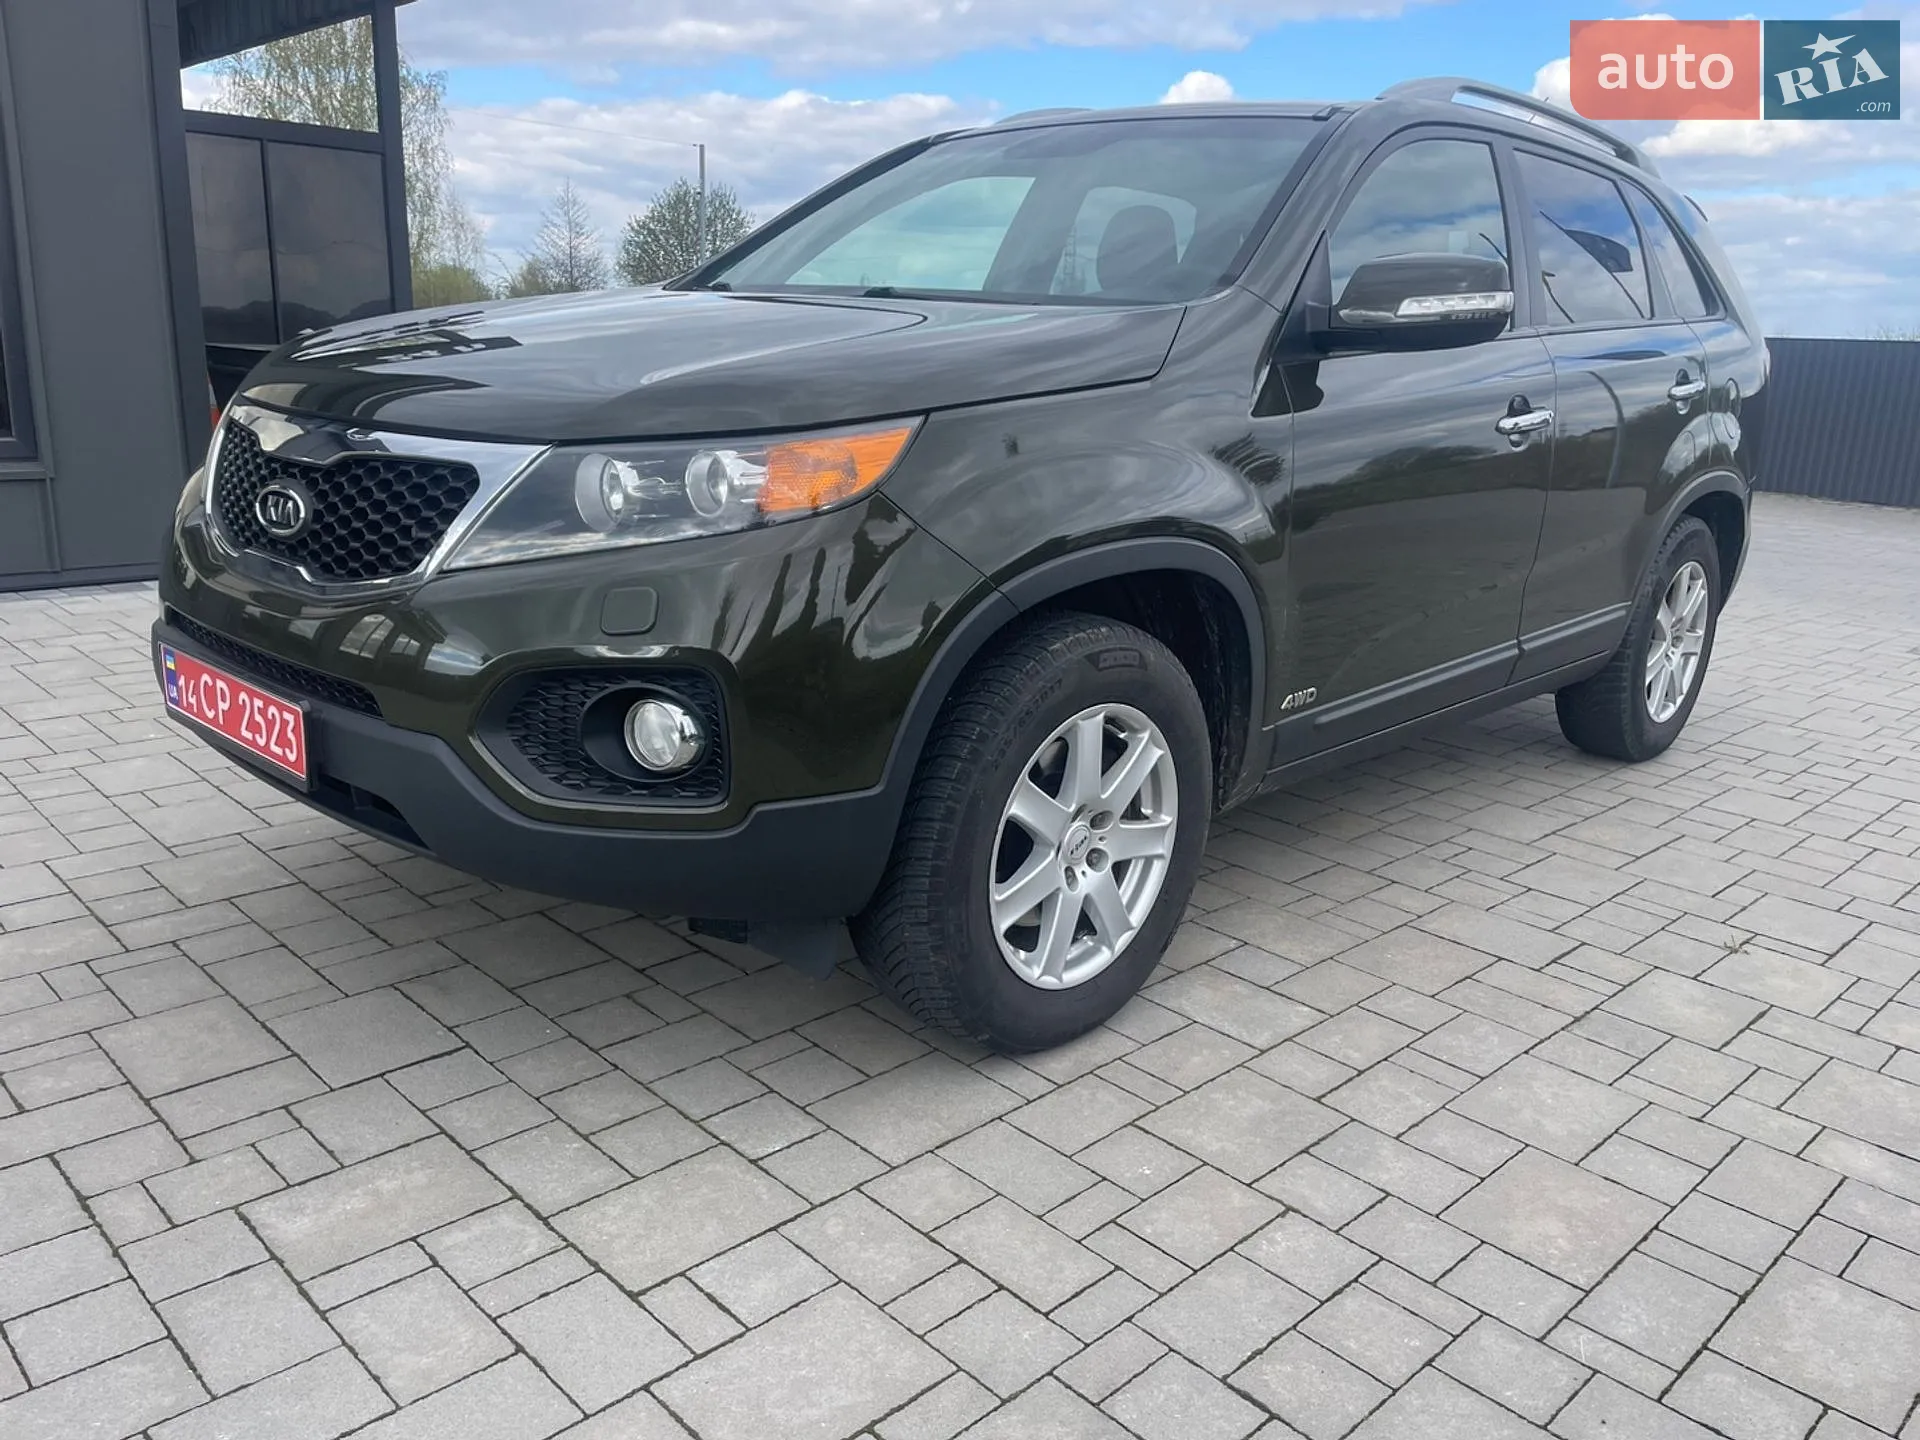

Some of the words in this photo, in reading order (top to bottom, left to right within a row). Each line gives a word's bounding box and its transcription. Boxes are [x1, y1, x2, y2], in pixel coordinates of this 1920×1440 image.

[265, 494, 295, 526] KIA
[168, 685, 178, 699] UA
[1281, 687, 1317, 710] 4WD
[239, 691, 298, 762] 2523
